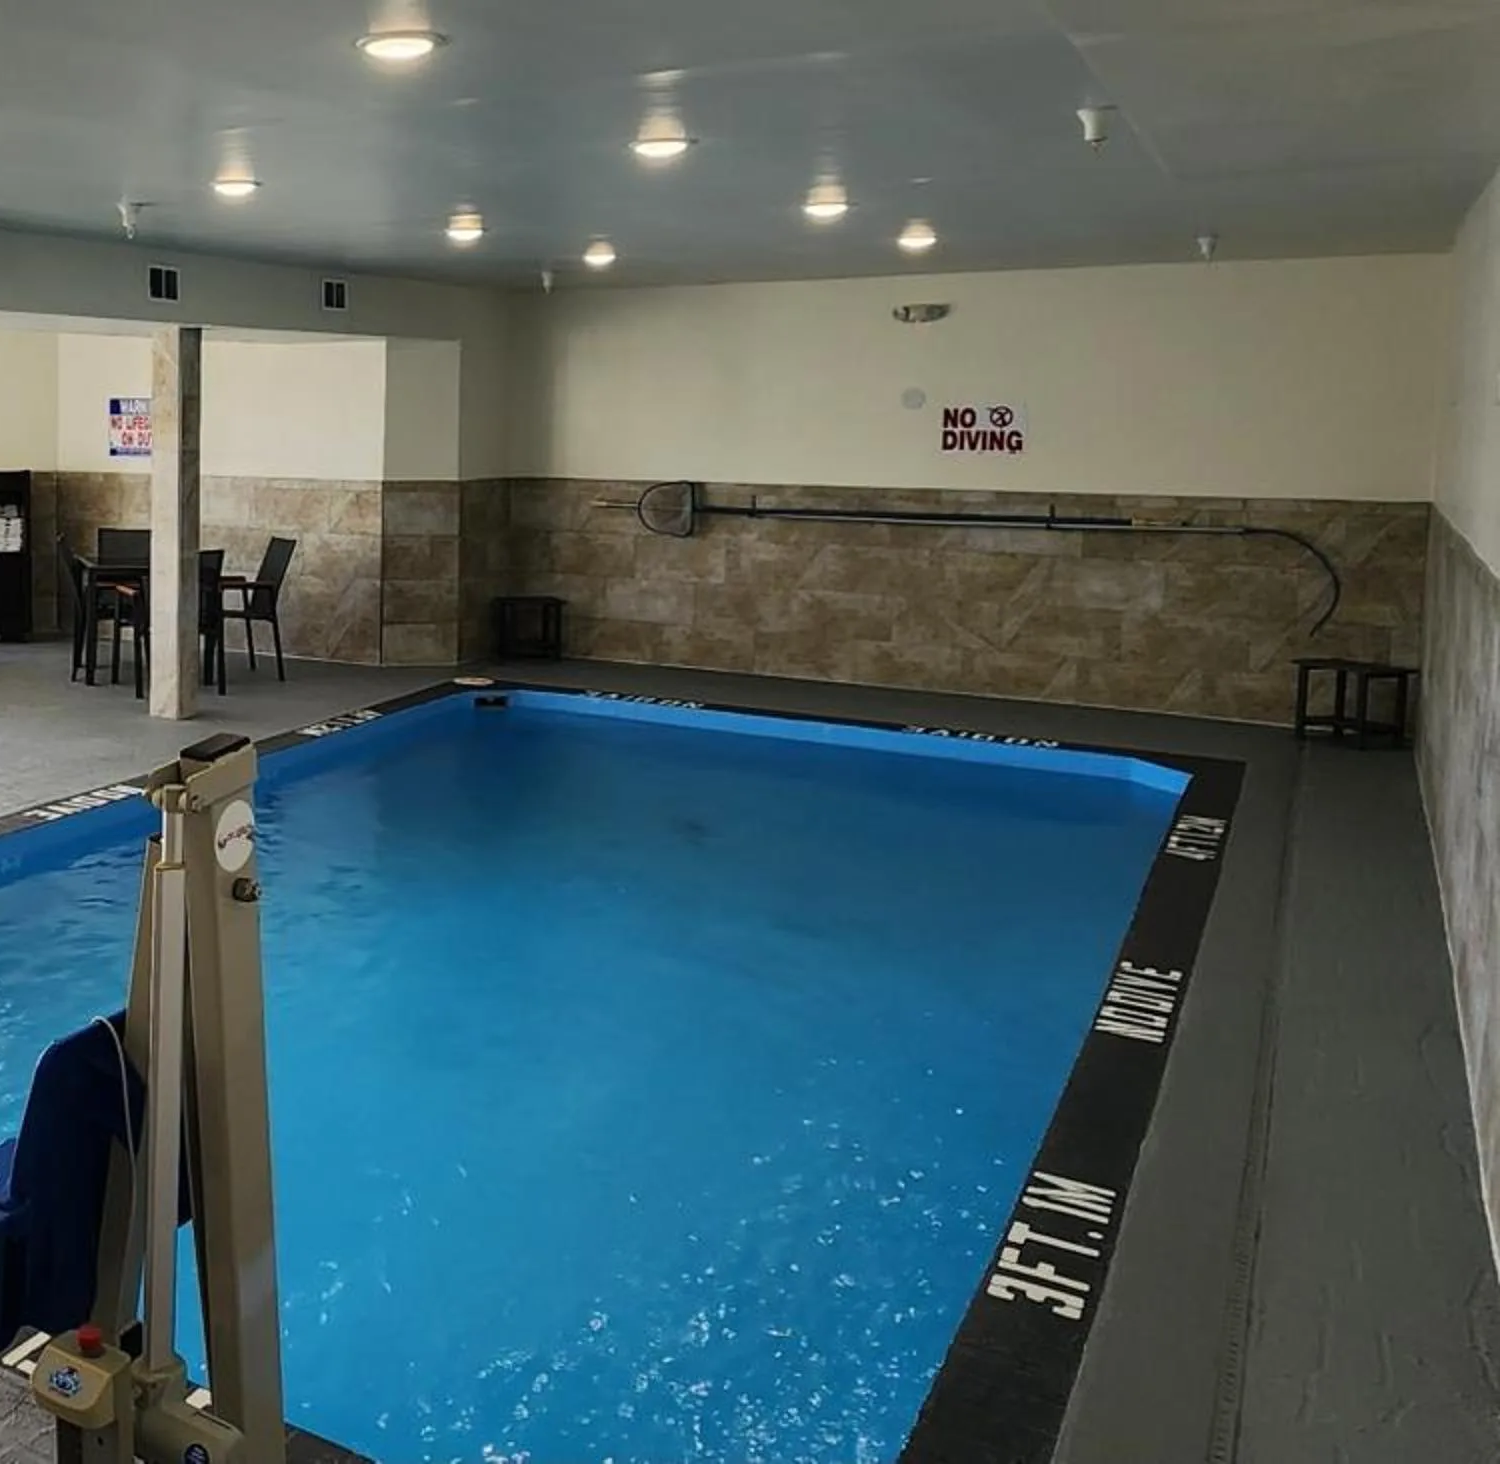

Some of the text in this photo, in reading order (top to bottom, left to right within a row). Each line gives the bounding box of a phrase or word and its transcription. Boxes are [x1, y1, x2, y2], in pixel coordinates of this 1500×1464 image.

[120, 400, 150, 413] WARN
[110, 416, 122, 430] NO
[943, 407, 976, 429] NO
[942, 430, 1023, 452] DIVING
